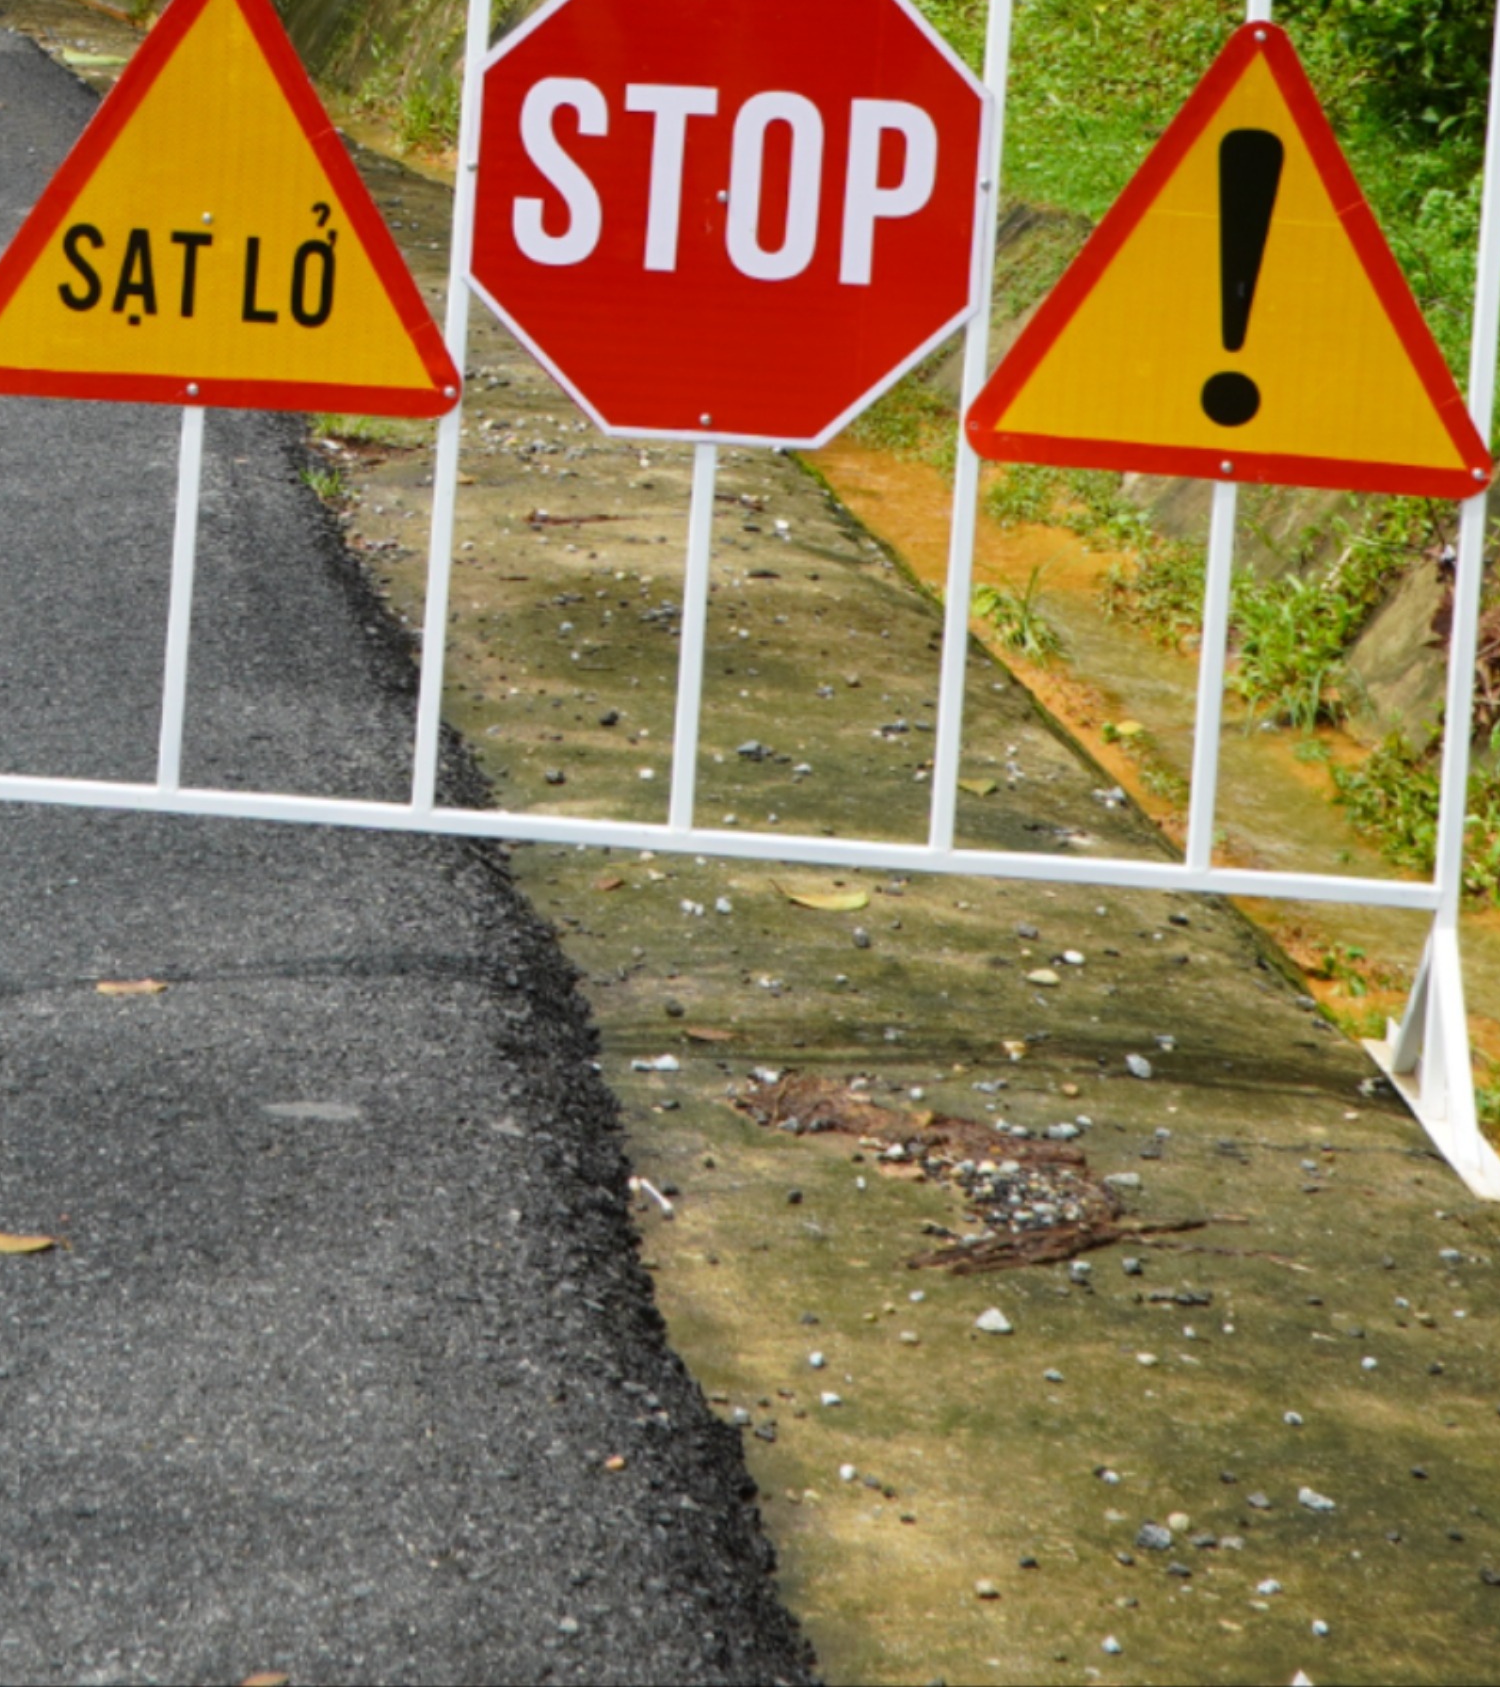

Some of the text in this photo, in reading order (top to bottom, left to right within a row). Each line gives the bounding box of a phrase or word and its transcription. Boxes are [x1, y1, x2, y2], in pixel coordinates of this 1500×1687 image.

[57, 202, 338, 328] SẠT LỞ
[511, 76, 939, 286] STOP
